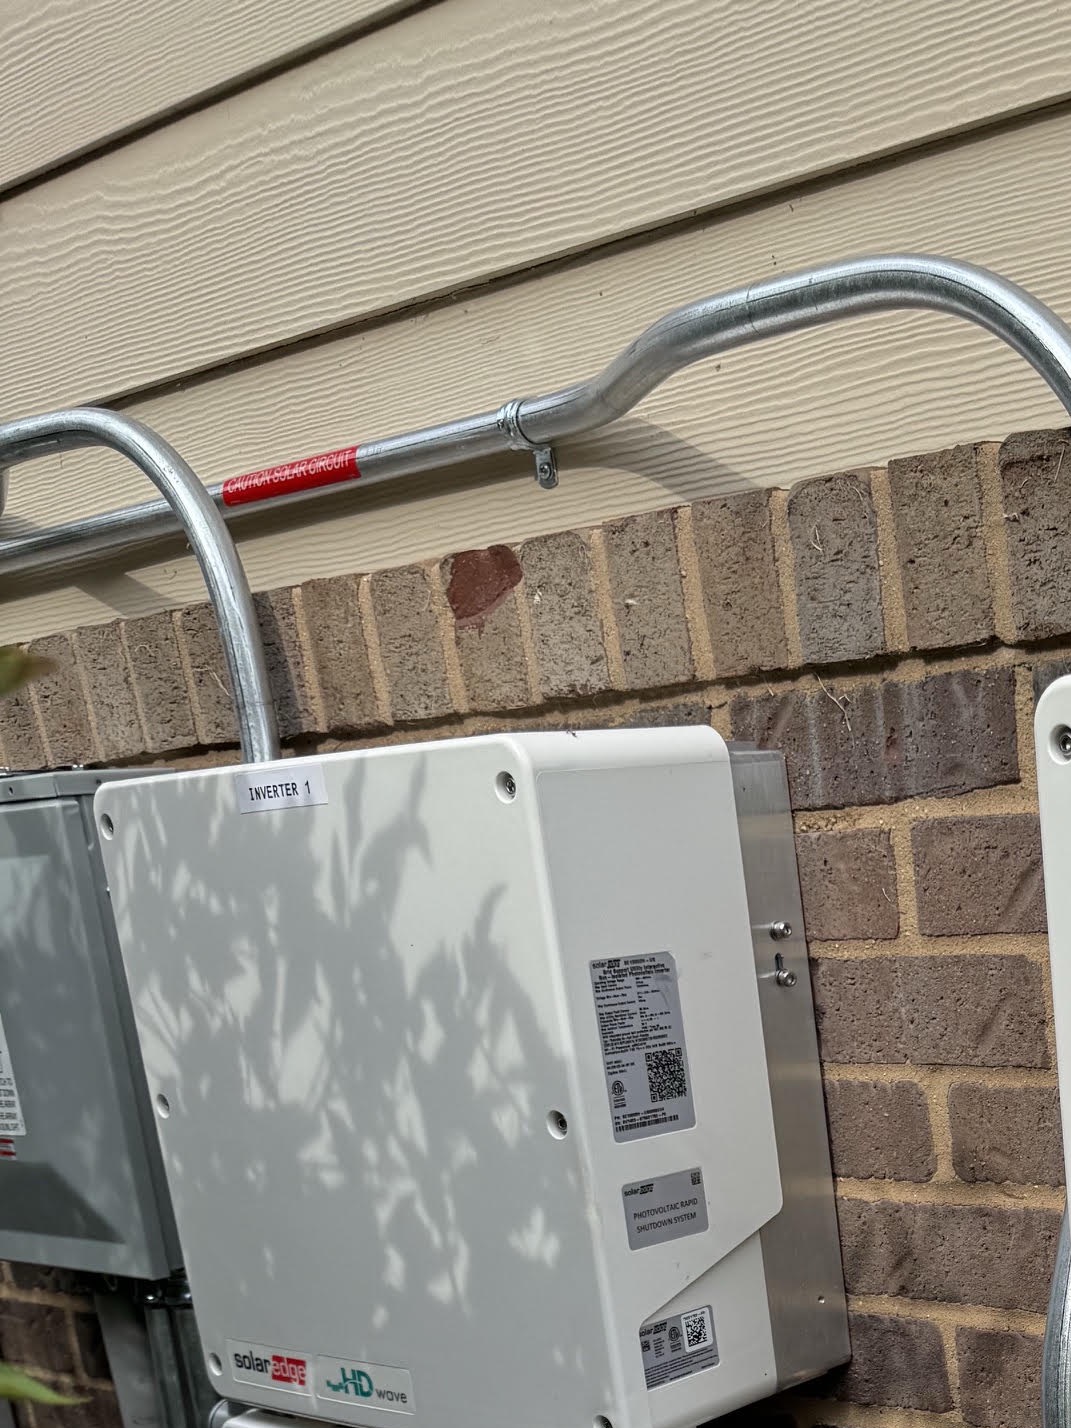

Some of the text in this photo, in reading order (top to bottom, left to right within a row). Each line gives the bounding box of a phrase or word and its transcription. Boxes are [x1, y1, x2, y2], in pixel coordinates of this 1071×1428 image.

[228, 470, 272, 493] CAUTION
[272, 461, 307, 483] SOLAR
[309, 450, 352, 474] CIRCUIT
[248, 780, 311, 801] INVERTER 1
[633, 1198, 698, 1220] PHOTOVOLTAIC RAPID
[636, 1212, 697, 1233] SHUTDOWN SYSTEM
[234, 1351, 307, 1386] solaredge
[375, 1388, 408, 1404] wave
